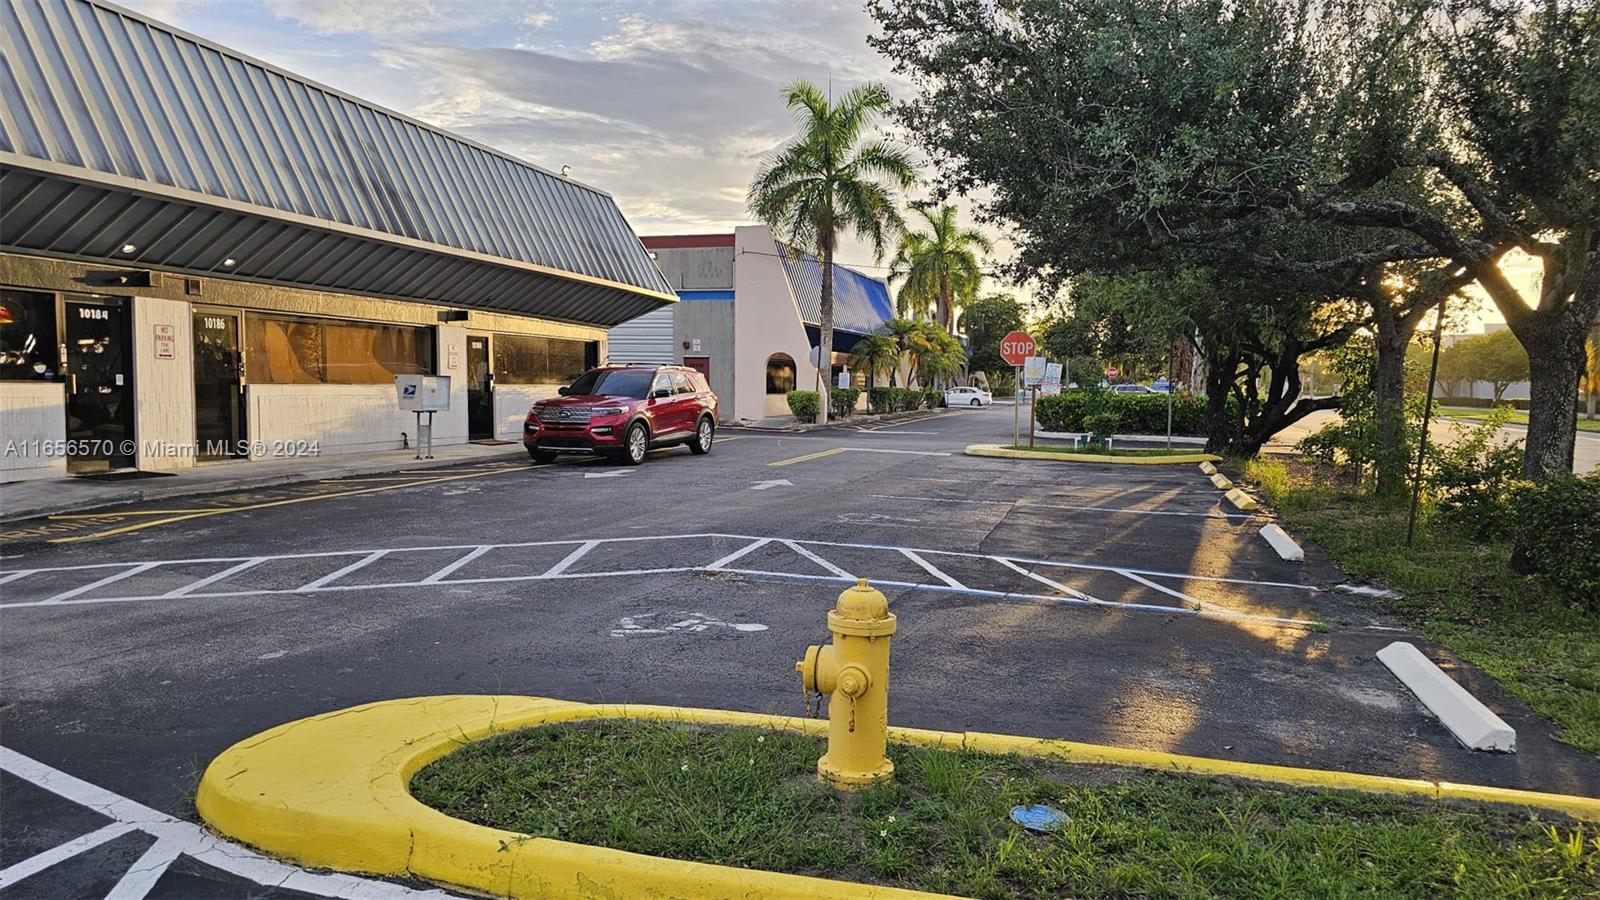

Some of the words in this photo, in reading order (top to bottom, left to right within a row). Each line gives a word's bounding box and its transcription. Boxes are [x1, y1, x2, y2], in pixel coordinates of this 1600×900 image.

[79, 308, 109, 320] 10184
[204, 317, 225, 330] 10186
[1003, 342, 1034, 355] STOP
